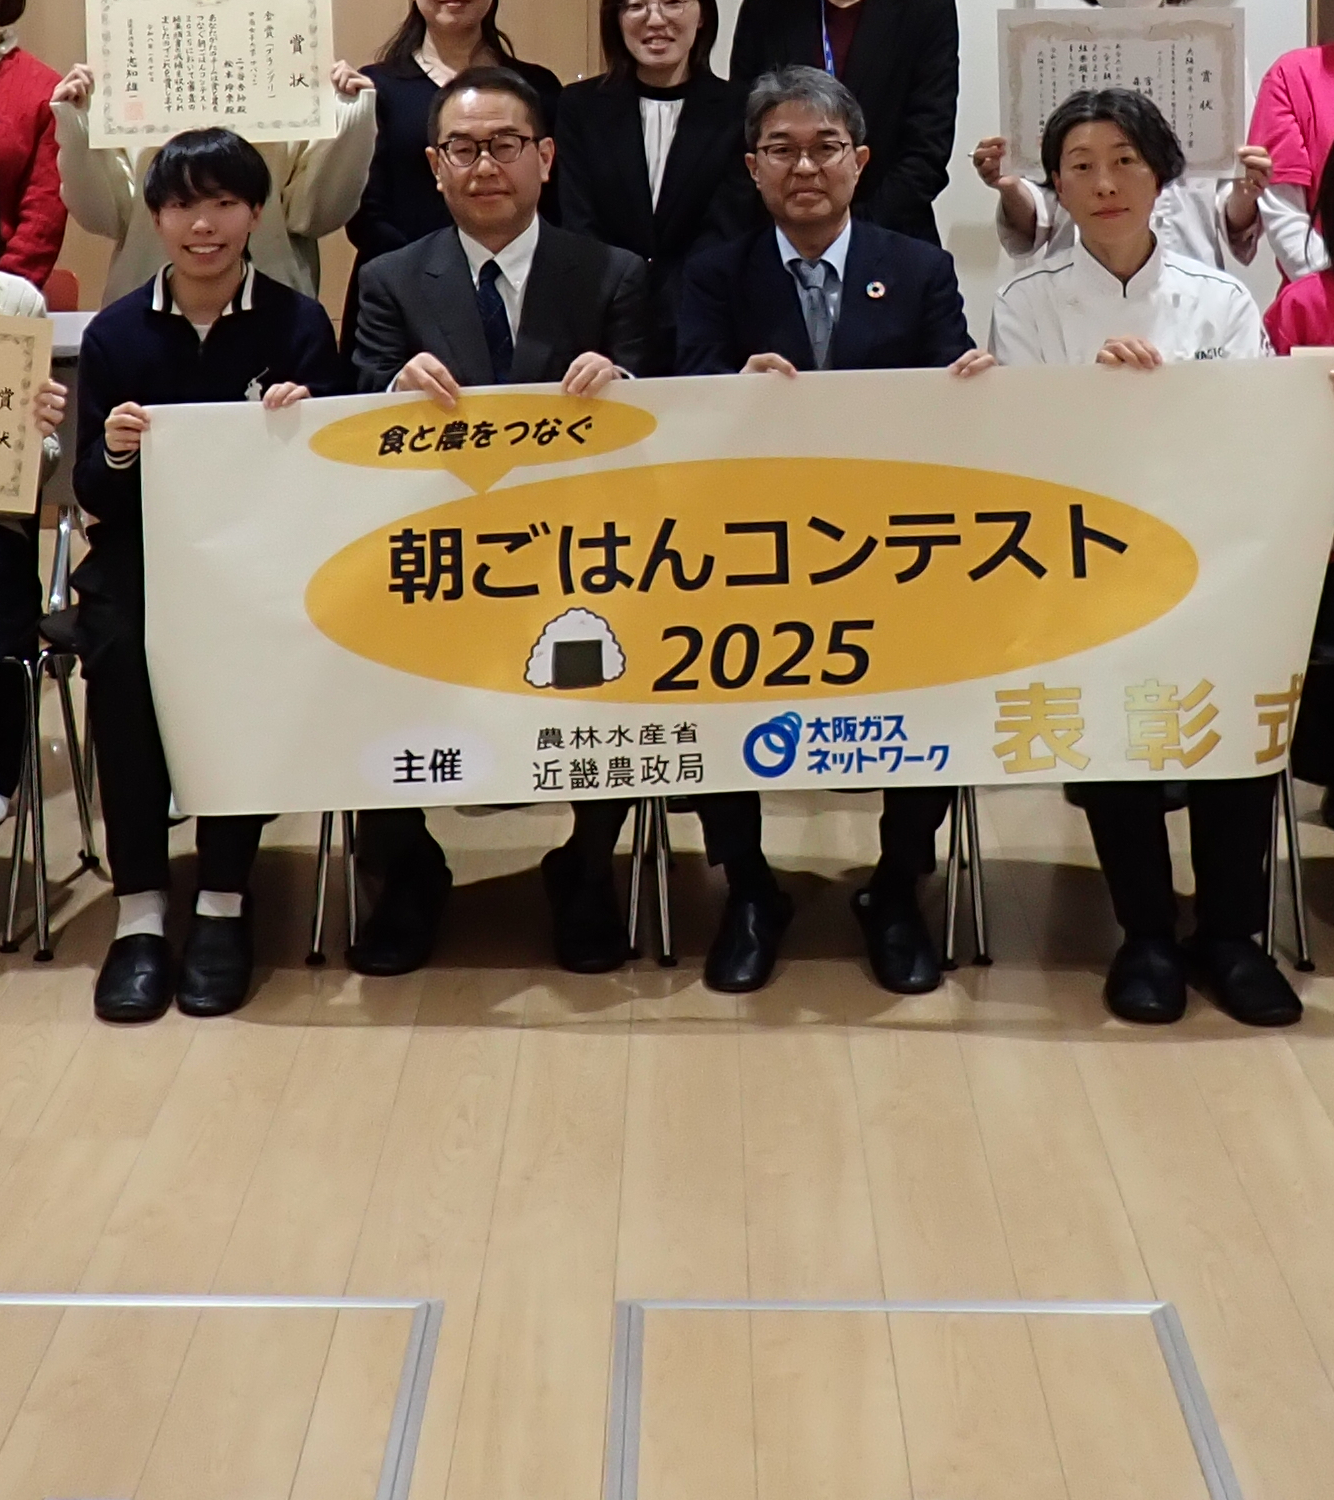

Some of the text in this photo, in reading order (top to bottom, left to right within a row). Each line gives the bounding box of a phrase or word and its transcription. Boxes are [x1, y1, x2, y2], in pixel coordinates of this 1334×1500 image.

[289, 33, 309, 88] 賞状
[1199, 69, 1214, 111] 賞状
[378, 415, 595, 457] 食と農をつなぐ
[389, 505, 1129, 606] 朝ごはんコンテスト
[653, 620, 876, 693] 2025
[536, 722, 699, 750] 農林水産省
[806, 713, 908, 743] 大阪ガス
[992, 674, 1304, 774] 表彰式
[392, 748, 463, 783] 主催
[532, 753, 705, 791] 近畿農政局
[807, 744, 950, 775] ネットワーク
